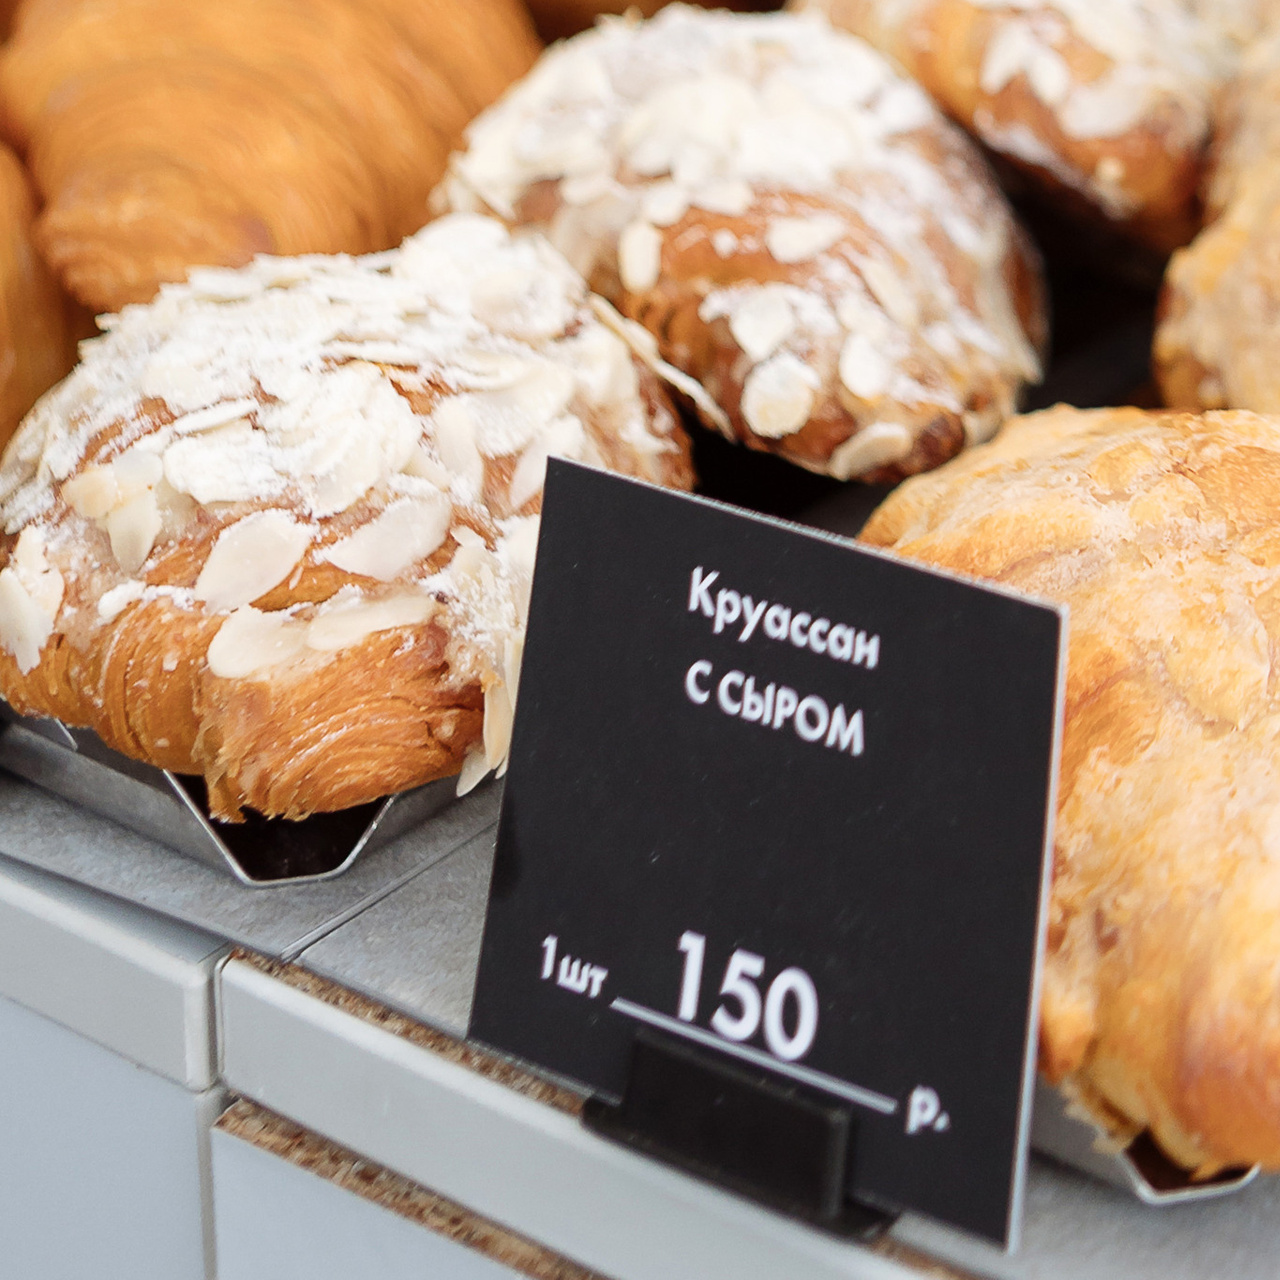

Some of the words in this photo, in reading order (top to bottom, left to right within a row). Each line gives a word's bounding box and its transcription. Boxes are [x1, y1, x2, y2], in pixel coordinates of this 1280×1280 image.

[687, 565, 881, 670] Круассан
[716, 668, 866, 758] СЫРОМ
[677, 929, 820, 1062] 150
